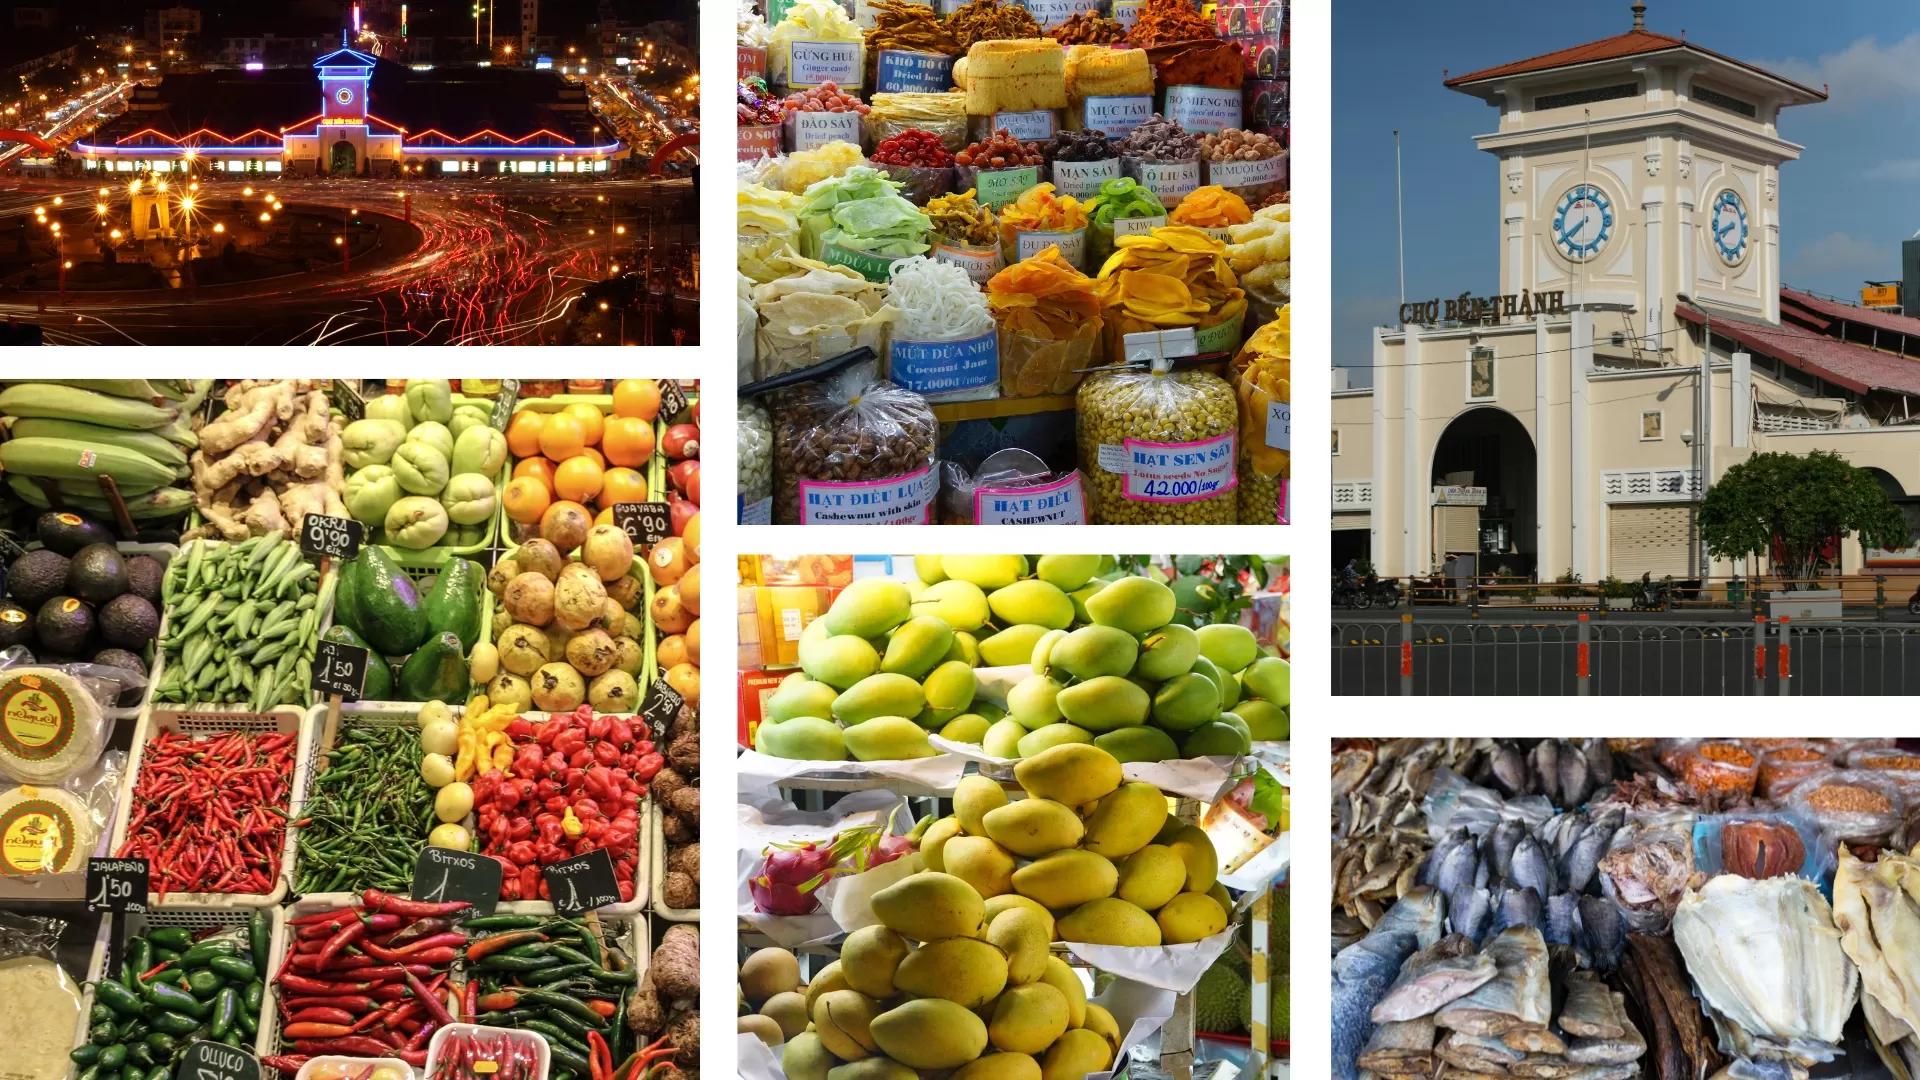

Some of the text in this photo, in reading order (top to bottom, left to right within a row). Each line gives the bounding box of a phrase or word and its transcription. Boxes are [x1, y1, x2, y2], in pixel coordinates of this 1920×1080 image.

[802, 63, 852, 74] Ginger candy
[894, 70, 922, 80] Dried
[805, 132, 850, 142] Dried peach
[1256, 160, 1275, 173] CAY
[1160, 171, 1180, 181] LIU
[1063, 181, 1084, 189] Dried
[1150, 184, 1175, 193] Dried
[1399, 297, 1439, 324] CHỢ
[906, 358, 988, 374] Coconut Jam
[1133, 451, 1169, 468] HẠT
[1173, 451, 1207, 467] SEN
[1133, 469, 1161, 480] Lotus
[1163, 471, 1191, 480] seeds
[1193, 468, 1206, 478] No
[808, 493, 845, 508] HẠT
[994, 499, 1033, 515] HẠT
[615, 503, 665, 514] GUAYABA
[814, 498, 922, 521] Cashewnut with skin
[308, 515, 348, 532] OKRA
[1001, 510, 1066, 525] CASHEWNUT
[310, 526, 350, 550] 9'90
[200, 1045, 244, 1072] OLLUCO
